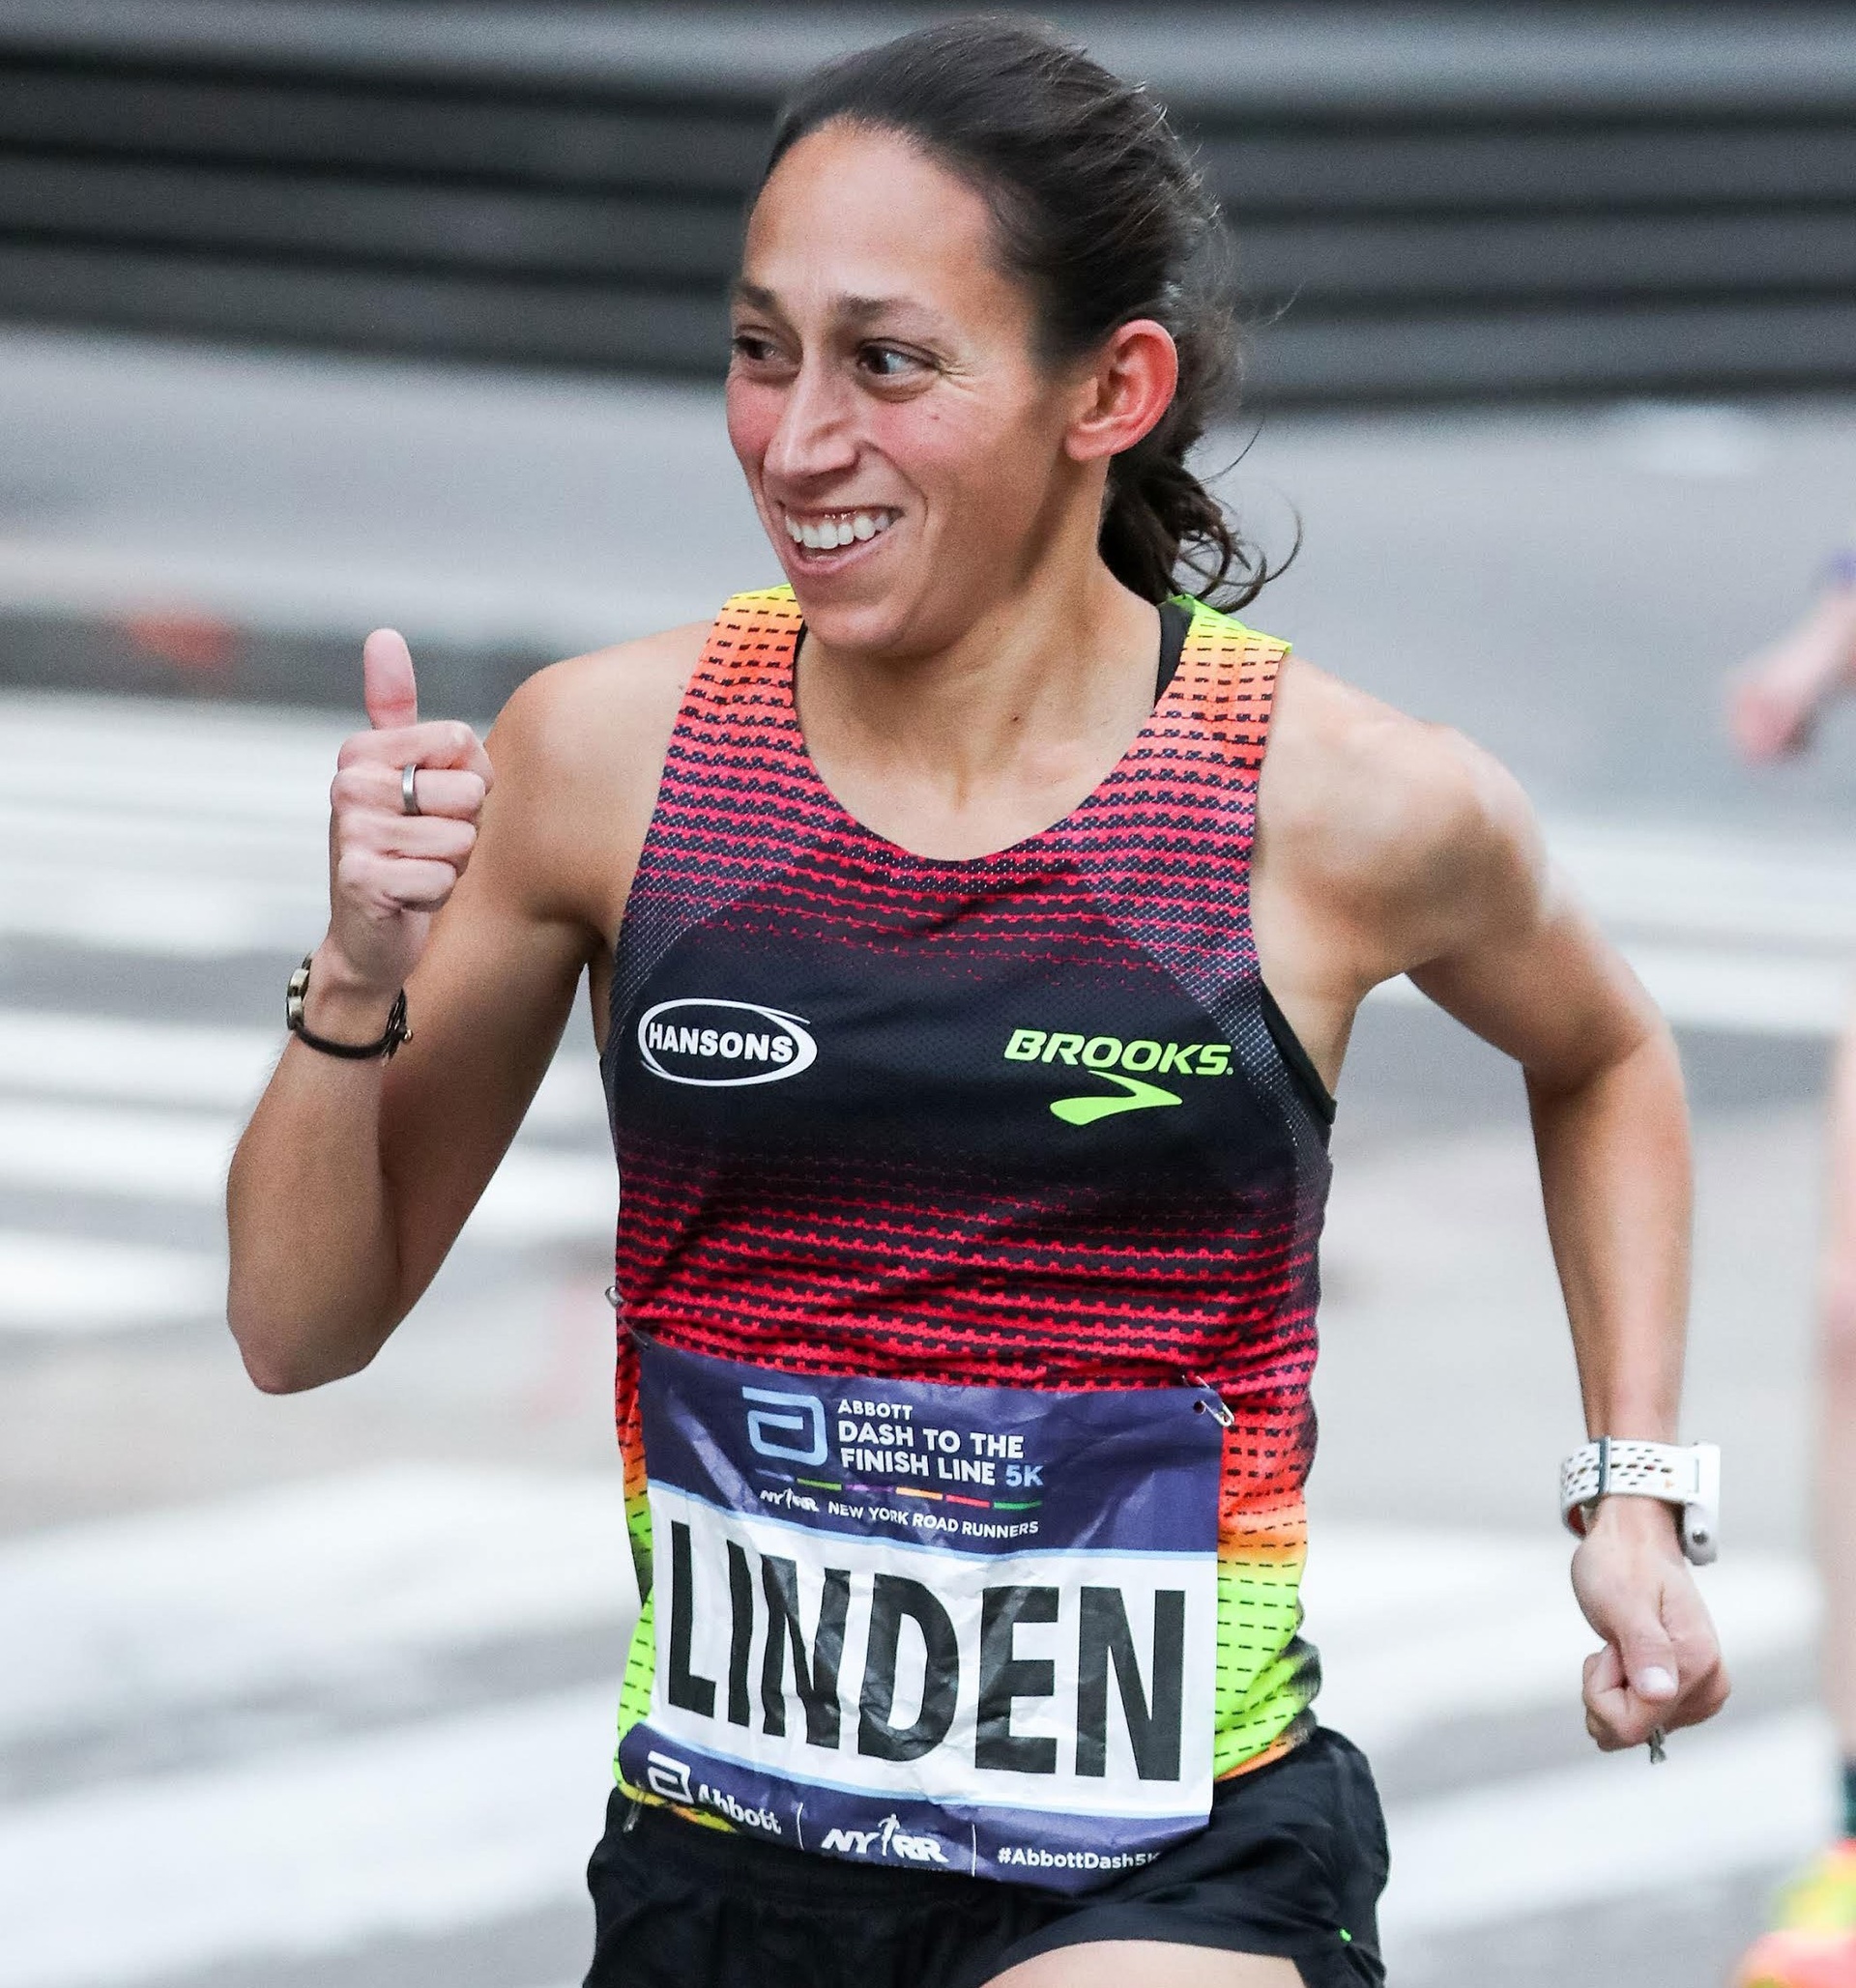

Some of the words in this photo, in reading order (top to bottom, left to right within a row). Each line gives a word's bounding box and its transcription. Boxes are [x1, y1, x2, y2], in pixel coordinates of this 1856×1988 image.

[649, 1022, 795, 1063] HANSONS
[1003, 1028, 1232, 1075] BROOKS
[837, 1398, 914, 1421] ABBOTT
[837, 1420, 914, 1448] DASH
[922, 1431, 961, 1454] TO
[970, 1433, 1025, 1459] THE
[840, 1447, 929, 1478] FINISH
[937, 1463, 996, 1486] LINE
[1005, 1464, 1044, 1487] 5K
[827, 1501, 864, 1520] NEW
[868, 1506, 909, 1526] YORK
[912, 1513, 959, 1533] ROAD
[962, 1520, 1039, 1540] RUNNERS
[668, 1519, 1186, 1782] LINDEN
